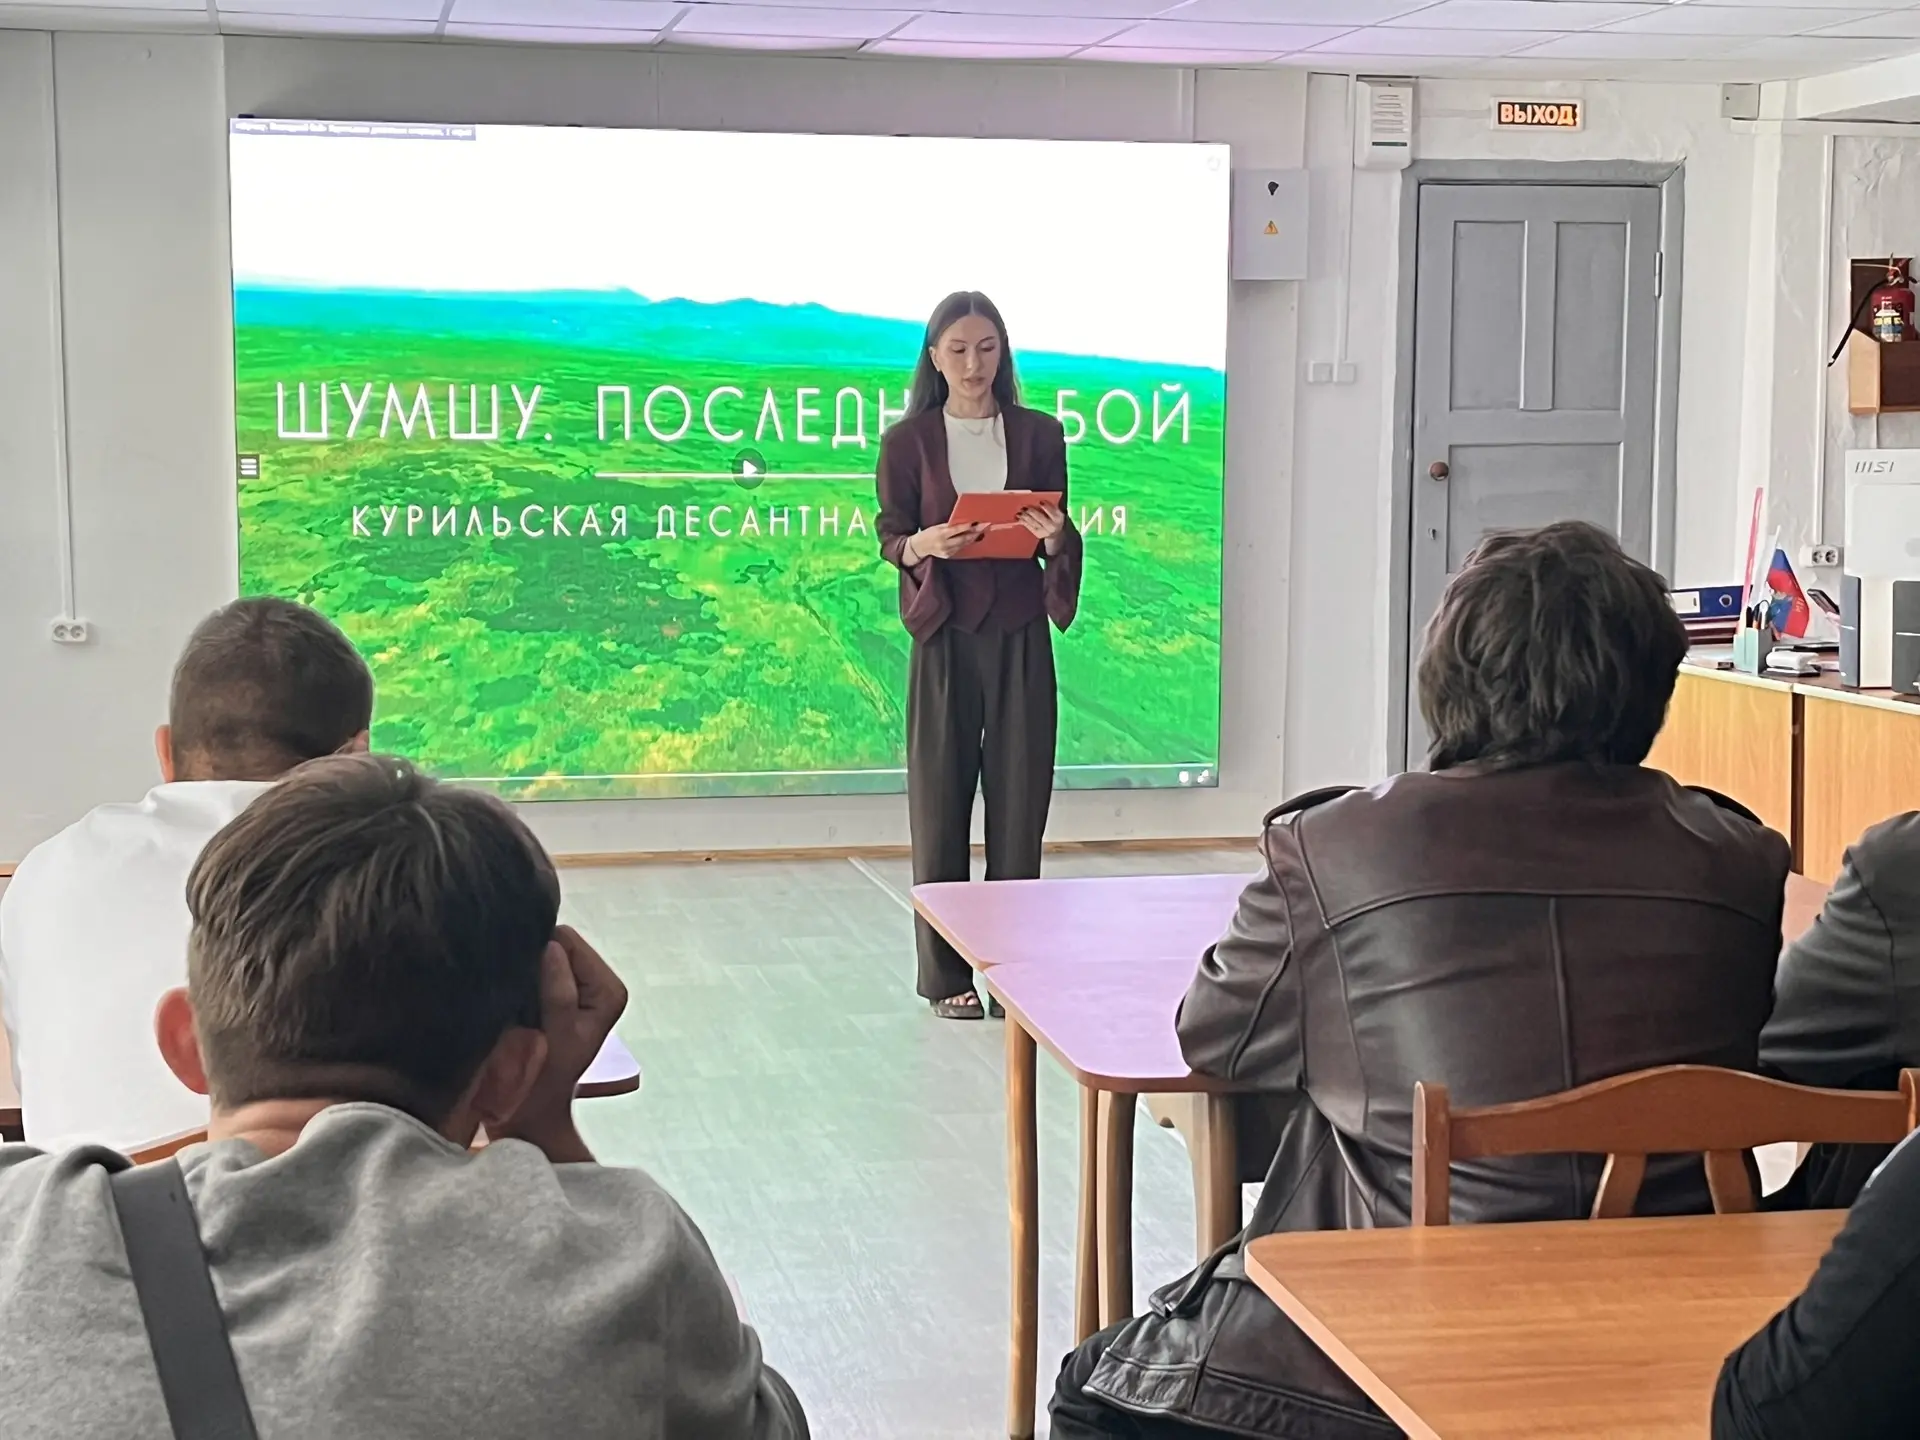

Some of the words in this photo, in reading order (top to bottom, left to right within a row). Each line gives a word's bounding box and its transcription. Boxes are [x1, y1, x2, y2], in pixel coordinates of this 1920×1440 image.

[1500, 103, 1574, 126] ВЫХОД
[276, 381, 553, 442] ШУМШУ.
[597, 385, 911, 449] ПОСЛЕДН
[1056, 382, 1190, 445] БОЙ
[351, 504, 628, 540] КУРИЛЬСКАЯ
[655, 505, 869, 540] ДЕСАНТНА
